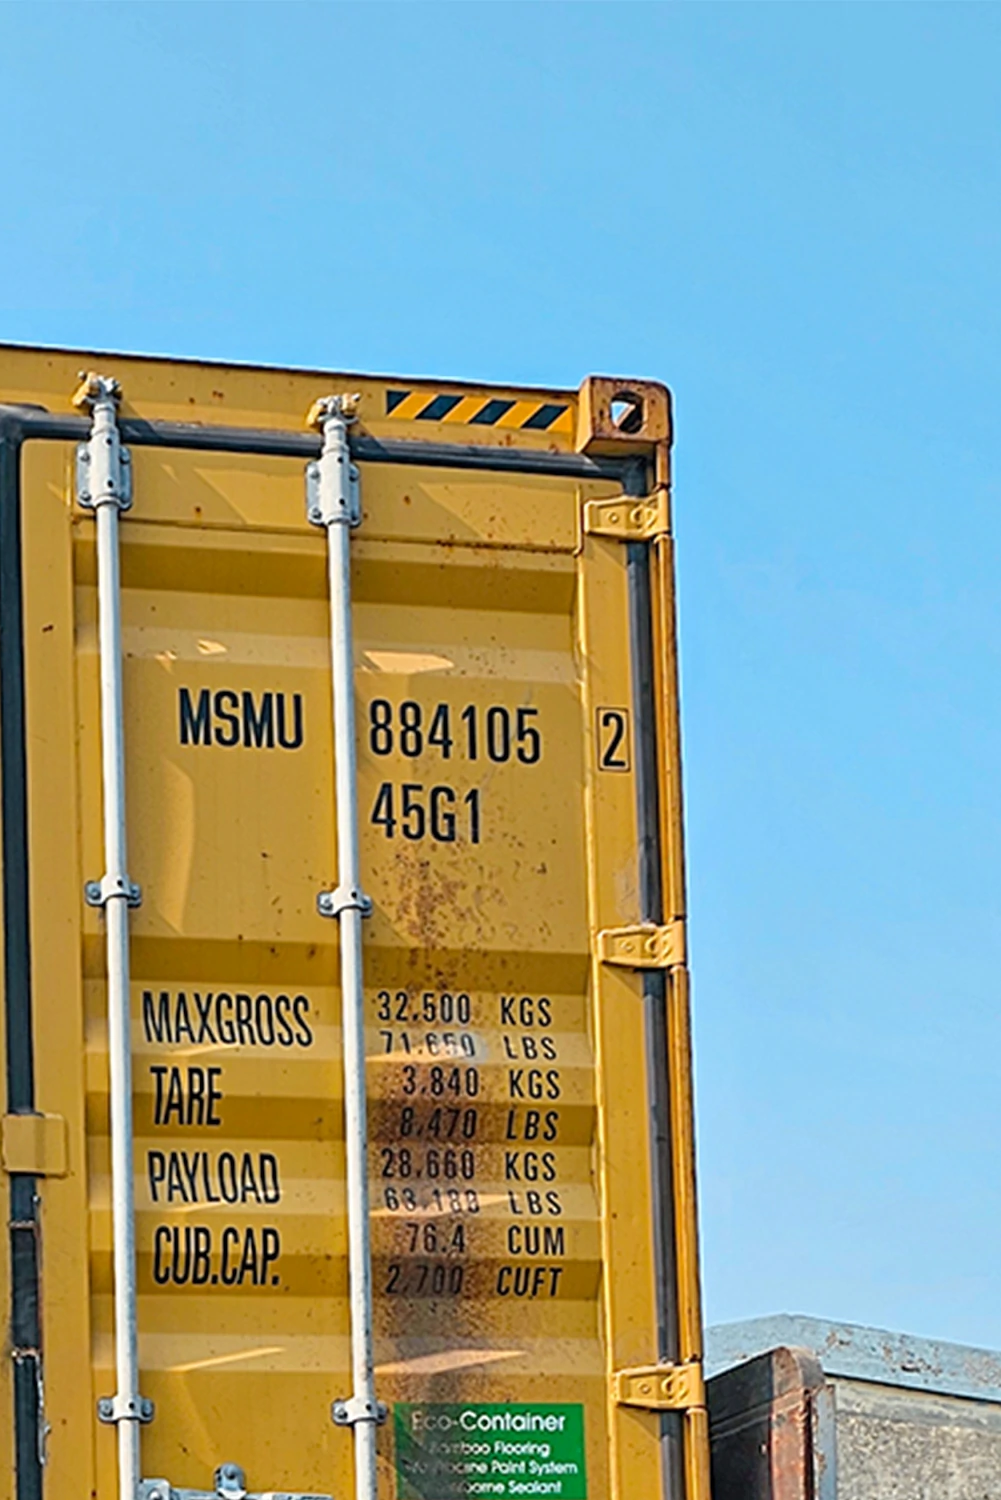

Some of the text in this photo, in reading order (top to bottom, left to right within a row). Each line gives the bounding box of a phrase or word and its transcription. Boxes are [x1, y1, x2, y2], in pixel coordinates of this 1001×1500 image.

[178, 687, 627, 767] MSMU 884105 2
[371, 782, 480, 844] 45G1
[142, 990, 313, 1048] MAXGROSS
[501, 996, 552, 1027] KGS
[503, 1035, 558, 1061] LBS
[150, 1066, 223, 1126] TARE
[509, 1069, 561, 1100] KGS
[506, 1108, 559, 1141] LBS
[147, 1151, 281, 1205] PAYLOAD
[505, 1151, 556, 1182] KGS
[508, 1191, 562, 1215] LBS
[153, 1226, 281, 1286] CUB.CAP.
[507, 1224, 565, 1256] CUM
[496, 1266, 563, 1297] CUFT
[411, 1410, 567, 1431] Eco-Container
[493, 1440, 551, 1458] Flooring
[490, 1459, 527, 1475] Paint
[528, 1461, 578, 1477] System
[507, 1479, 563, 1495] Sealant
